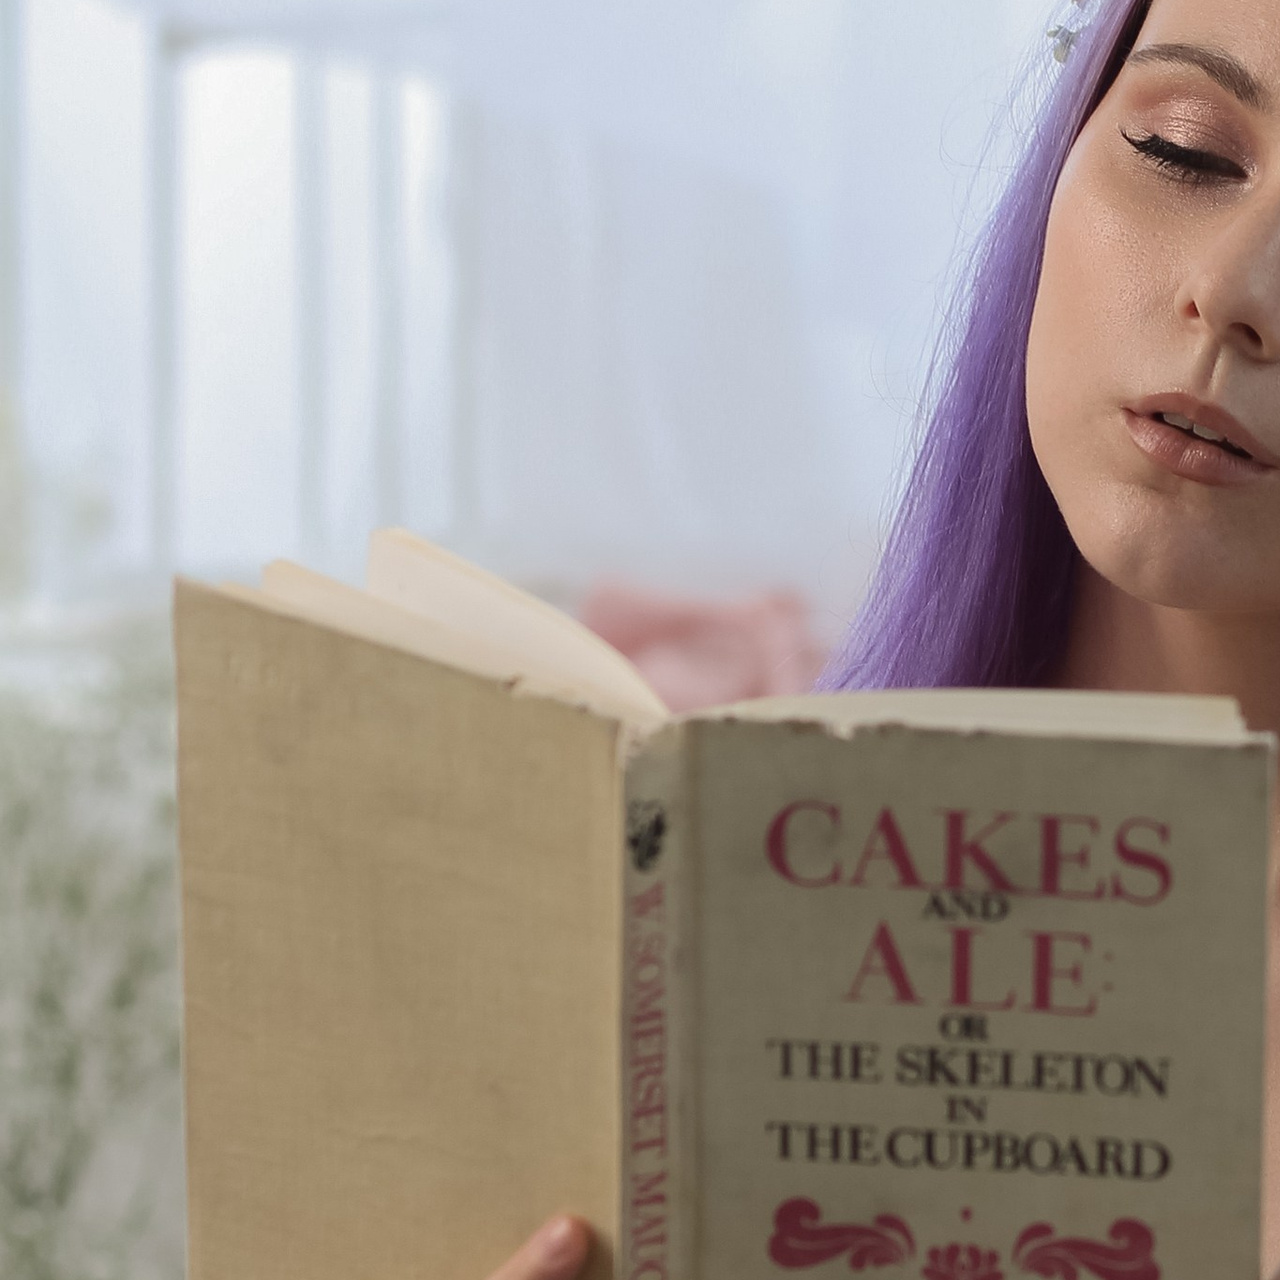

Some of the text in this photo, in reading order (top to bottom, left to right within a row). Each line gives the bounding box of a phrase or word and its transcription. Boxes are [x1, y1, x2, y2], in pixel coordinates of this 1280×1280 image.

[764, 799, 1174, 907] CAKES
[922, 891, 1010, 920] AND
[630, 932, 667, 1158] SOMERSET
[939, 1014, 989, 1043] OR
[765, 1040, 1171, 1098] THE SKELETON
[945, 1097, 987, 1123] IN
[765, 1122, 1172, 1182] THE CUPBOARD
